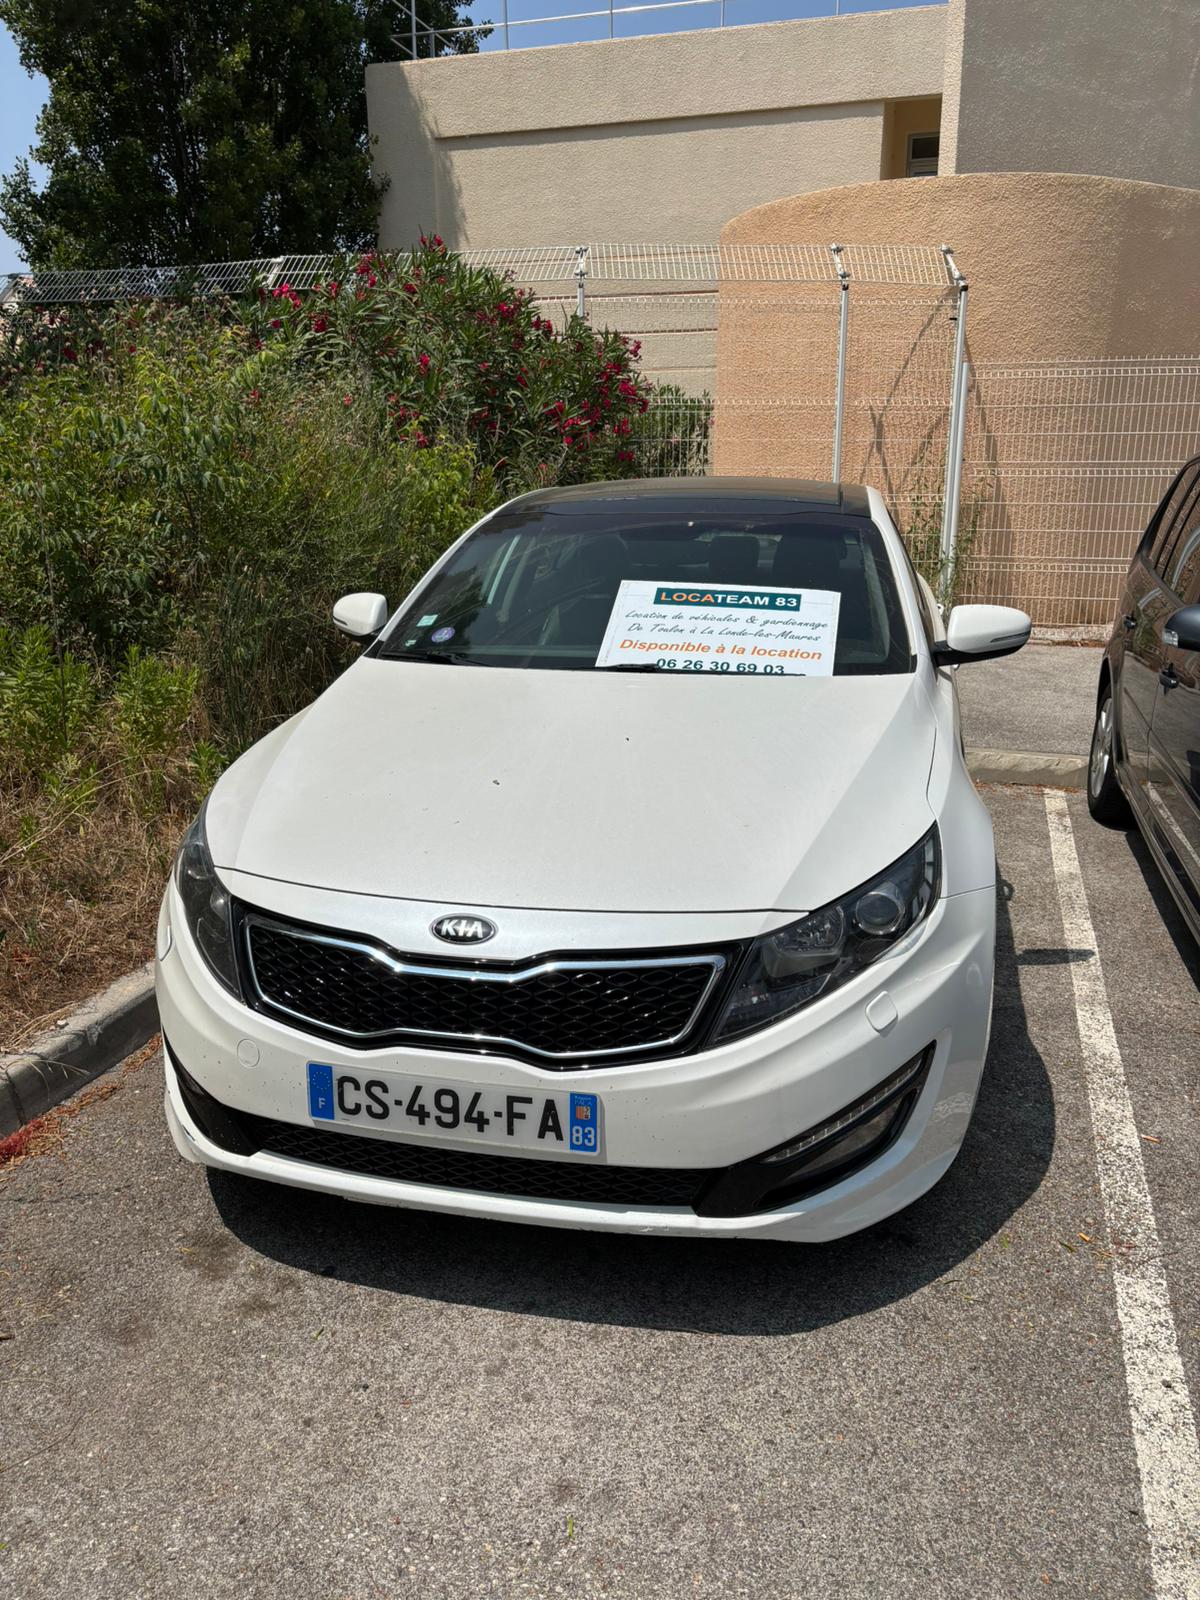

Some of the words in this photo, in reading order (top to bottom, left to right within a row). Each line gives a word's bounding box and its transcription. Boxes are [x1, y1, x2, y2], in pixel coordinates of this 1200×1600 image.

[661, 592, 770, 606] LOCATEAM
[775, 597, 798, 607] 83
[625, 610, 668, 620] Location
[671, 612, 685, 620] de
[688, 613, 741, 623] véhicules
[745, 615, 759, 624] &
[760, 618, 828, 630] gardiennage
[627, 622, 643, 632] De
[650, 623, 685, 634] Toulon
[689, 626, 698, 634] à
[700, 626, 715, 635] La
[718, 626, 822, 641] Londe-les-Maures
[619, 639, 711, 653] Disponible
[715, 643, 726, 654] à
[730, 645, 746, 656] la
[751, 646, 822, 660] location
[656, 658, 677, 669] 06
[682, 660, 704, 671] 26
[709, 661, 730, 672] 30
[736, 662, 757, 673] 69
[763, 664, 785, 674] 03
[440, 919, 484, 939] KIA
[318, 1097, 326, 1109] F
[337, 1075, 564, 1141] CS-494-FA
[572, 1125, 595, 1147] 83
